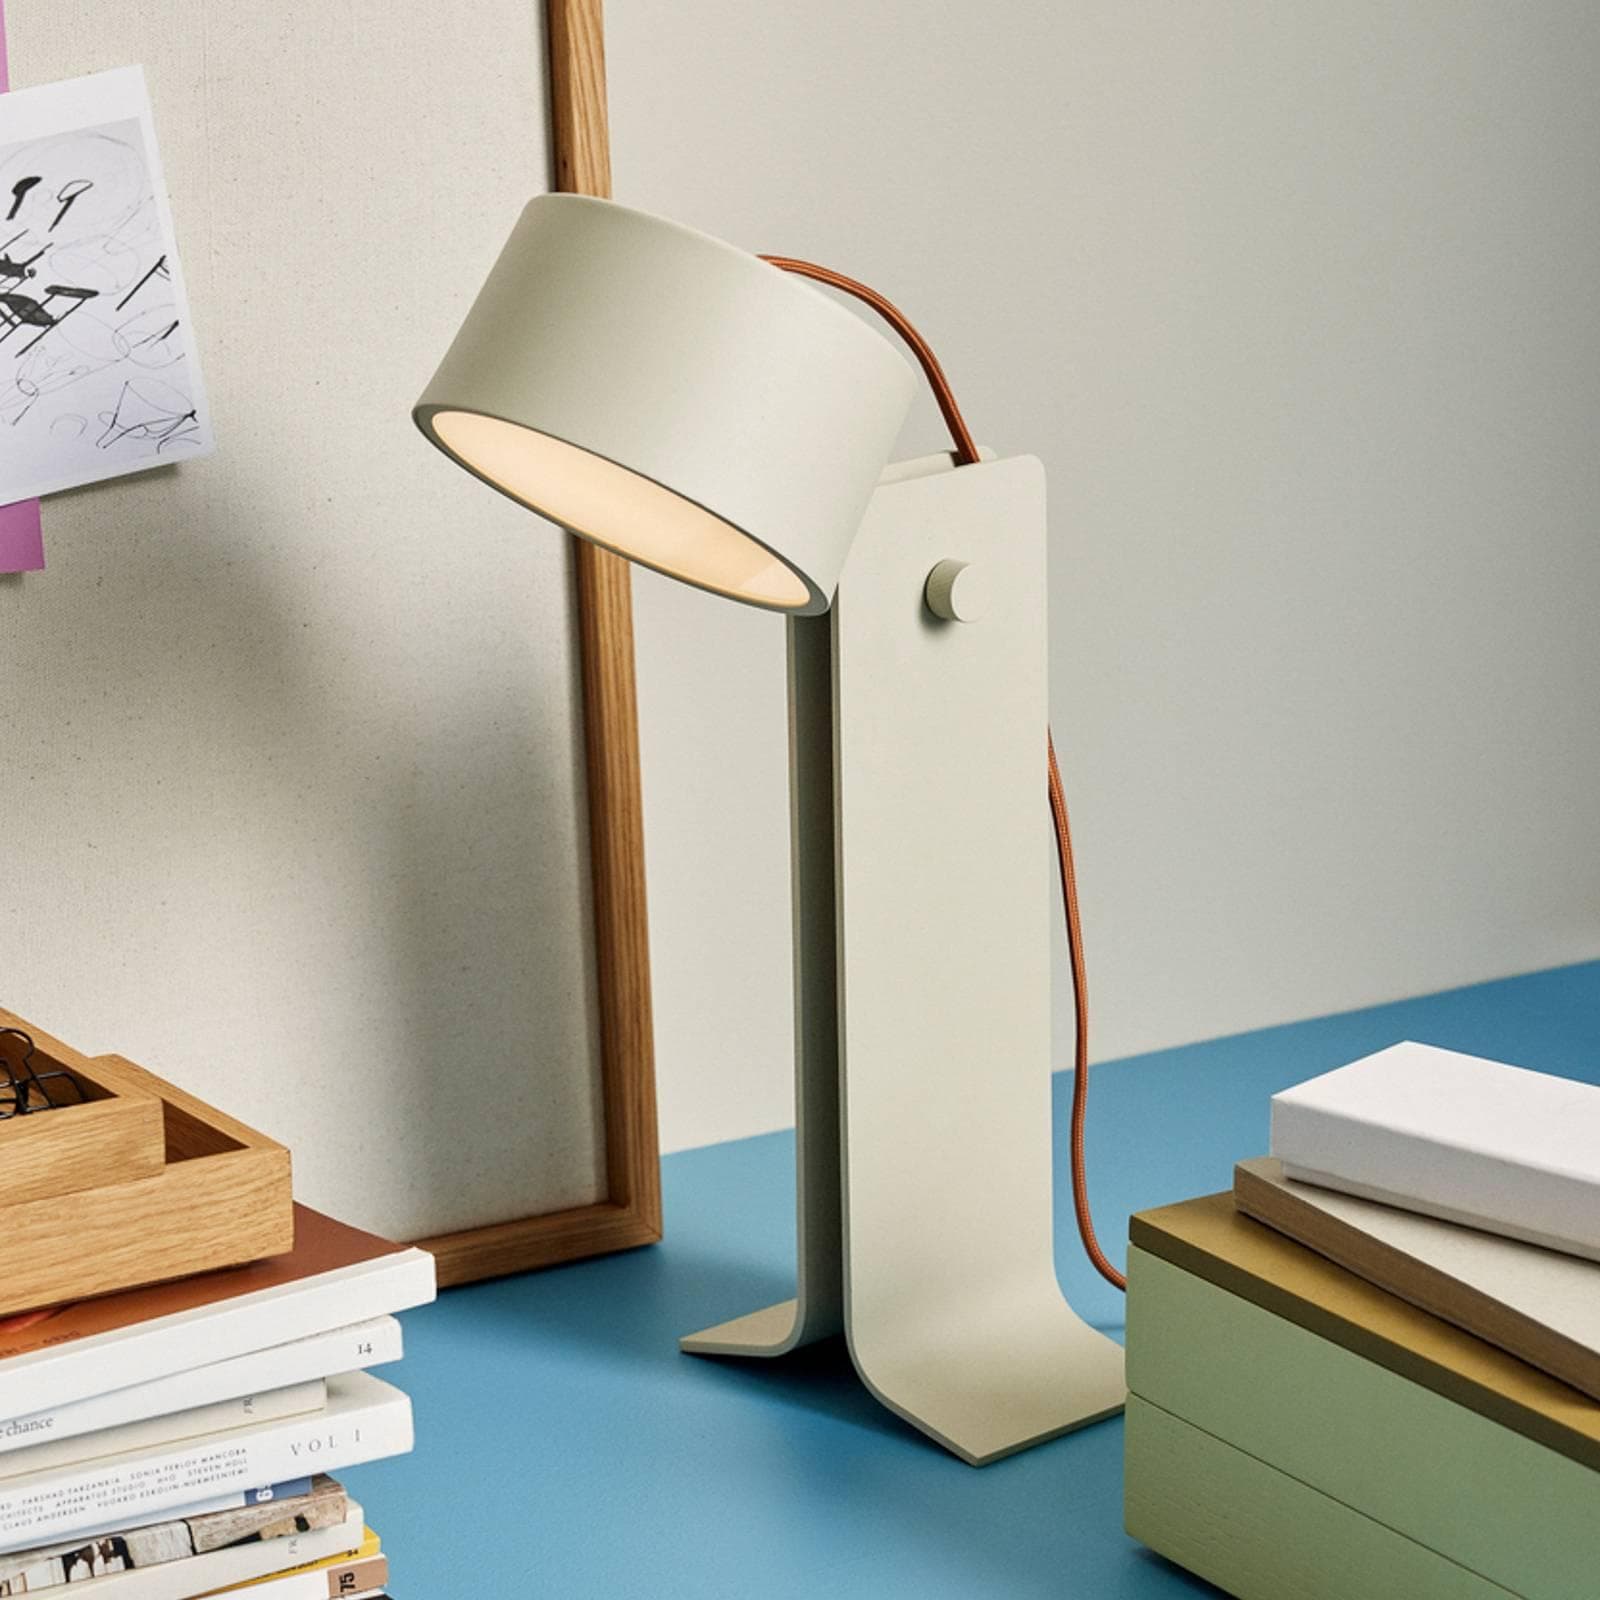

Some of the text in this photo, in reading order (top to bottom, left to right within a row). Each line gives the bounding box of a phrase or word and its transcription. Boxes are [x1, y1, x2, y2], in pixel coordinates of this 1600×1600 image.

[357, 1343, 373, 1355] 14
[6, 1417, 54, 1437] chance
[290, 1434, 337, 1456] VOL
[338, 1571, 356, 1593] 75
